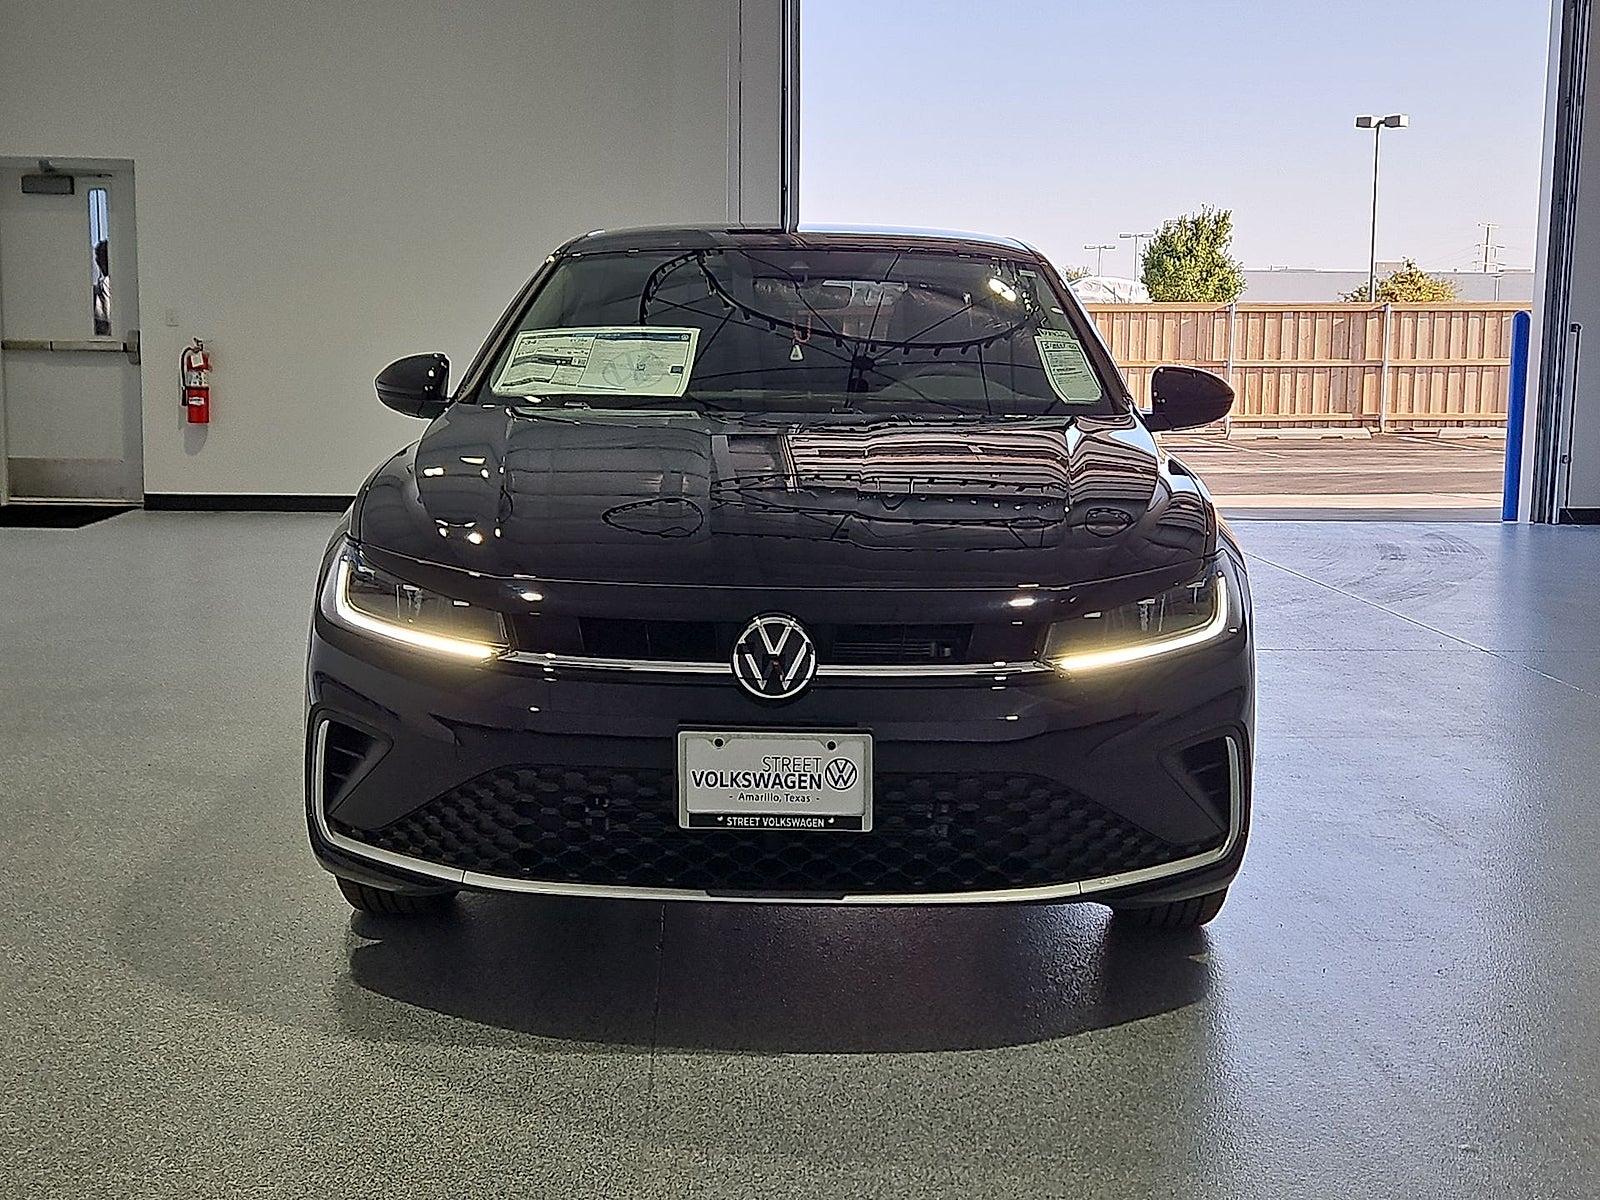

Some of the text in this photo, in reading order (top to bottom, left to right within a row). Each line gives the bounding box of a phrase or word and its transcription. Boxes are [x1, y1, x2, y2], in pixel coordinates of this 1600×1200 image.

[762, 756, 822, 773] STREET
[691, 770, 822, 790] VOLKSWAGEN
[738, 792, 811, 803] Amarillo, Texas
[726, 816, 825, 828] STREET VOLKSWAGEN
